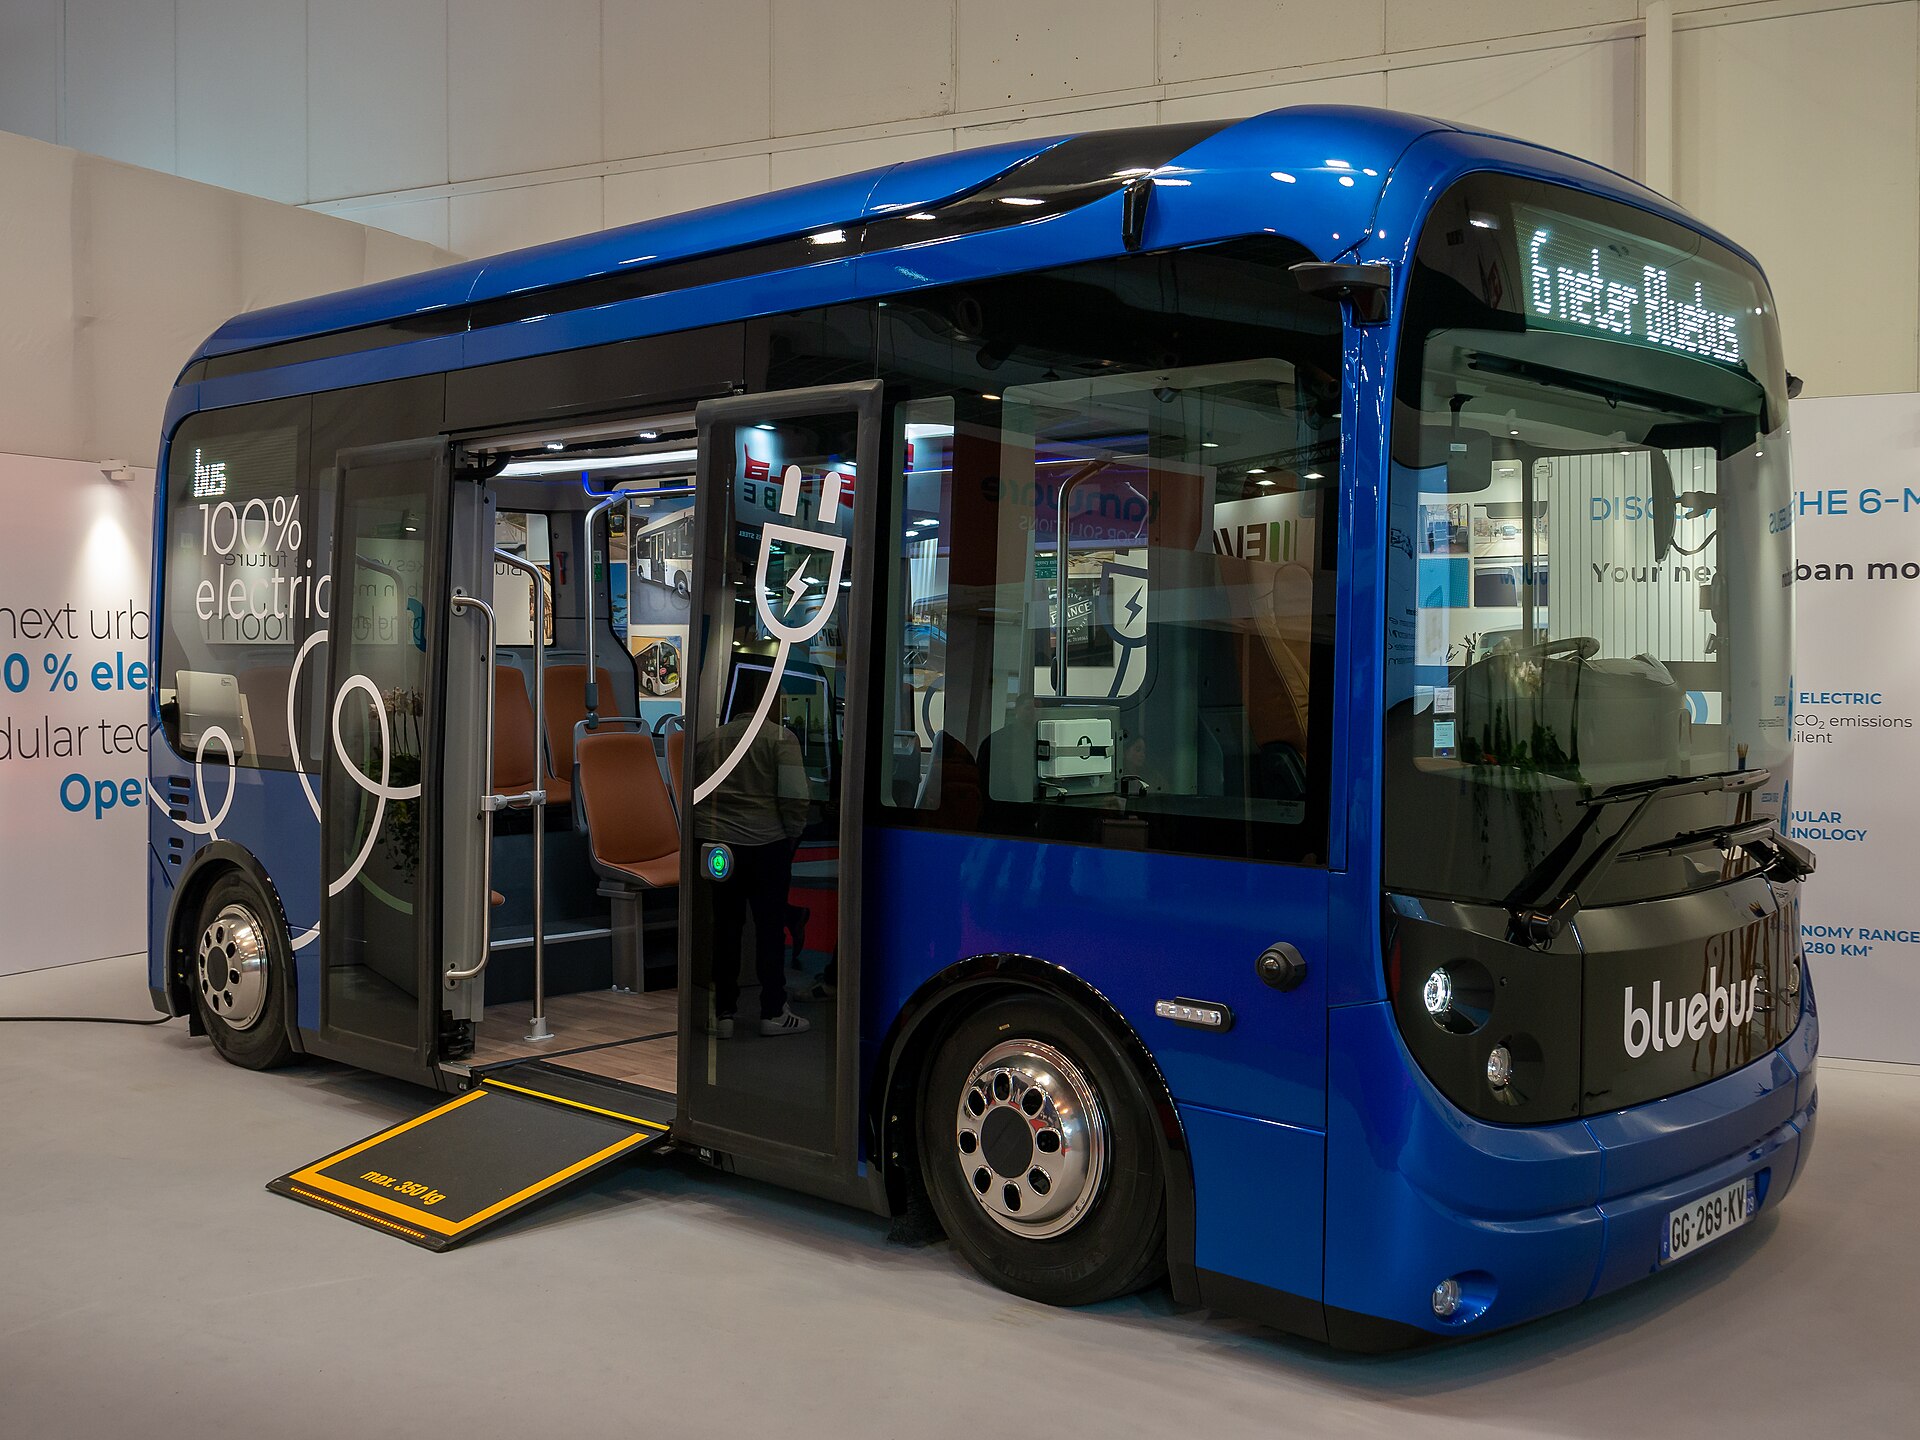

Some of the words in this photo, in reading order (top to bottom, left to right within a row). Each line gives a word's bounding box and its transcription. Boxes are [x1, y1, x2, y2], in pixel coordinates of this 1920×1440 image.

[1531, 230, 1551, 314] 6
[1643, 265, 1739, 363] Bluebus
[1794, 489, 1848, 516] HE
[199, 494, 302, 556] 100%
[1592, 563, 1662, 583] Your
[0, 652, 30, 693] 0
[43, 653, 78, 692] %
[1799, 691, 1882, 705] ELECTRIC
[1829, 714, 1913, 729] emissions
[1793, 730, 1833, 744] ilent
[60, 772, 148, 820] Ope
[1791, 809, 1842, 824] ULAR
[1859, 928, 1920, 943] RANGE
[1804, 941, 1836, 955] 280
[360, 1171, 397, 1188] max.
[394, 1180, 429, 1197] 350
[420, 1189, 447, 1206] kg
[1672, 1184, 1745, 1252] GG-269-KV
